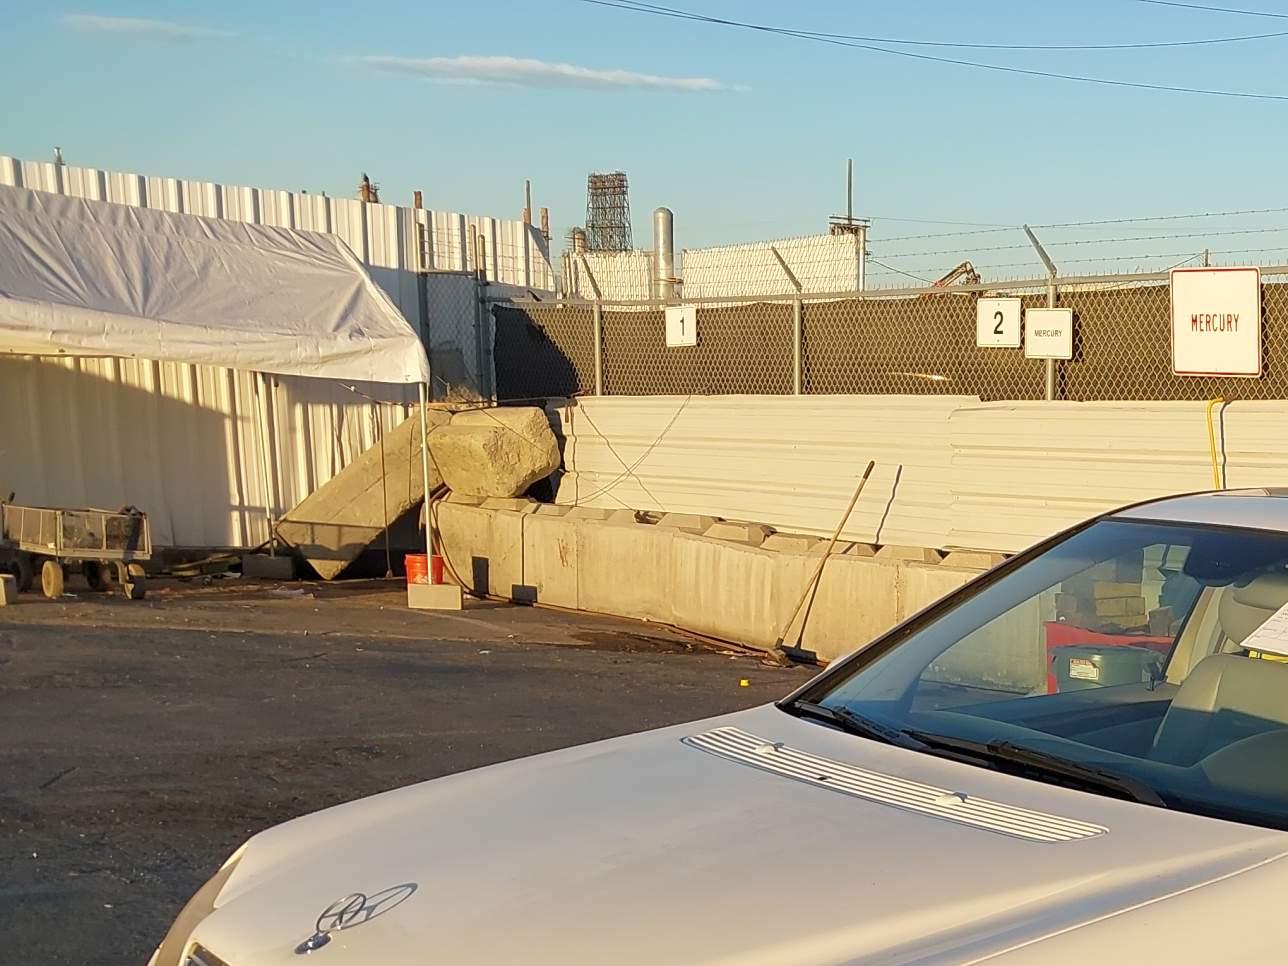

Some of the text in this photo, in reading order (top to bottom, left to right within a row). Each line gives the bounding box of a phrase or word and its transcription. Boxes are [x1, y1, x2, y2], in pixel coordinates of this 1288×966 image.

[679, 317, 685, 337] 1
[993, 311, 1004, 335] 2
[1191, 313, 1241, 333] MERCURY
[1034, 329, 1062, 338] MERCURY
